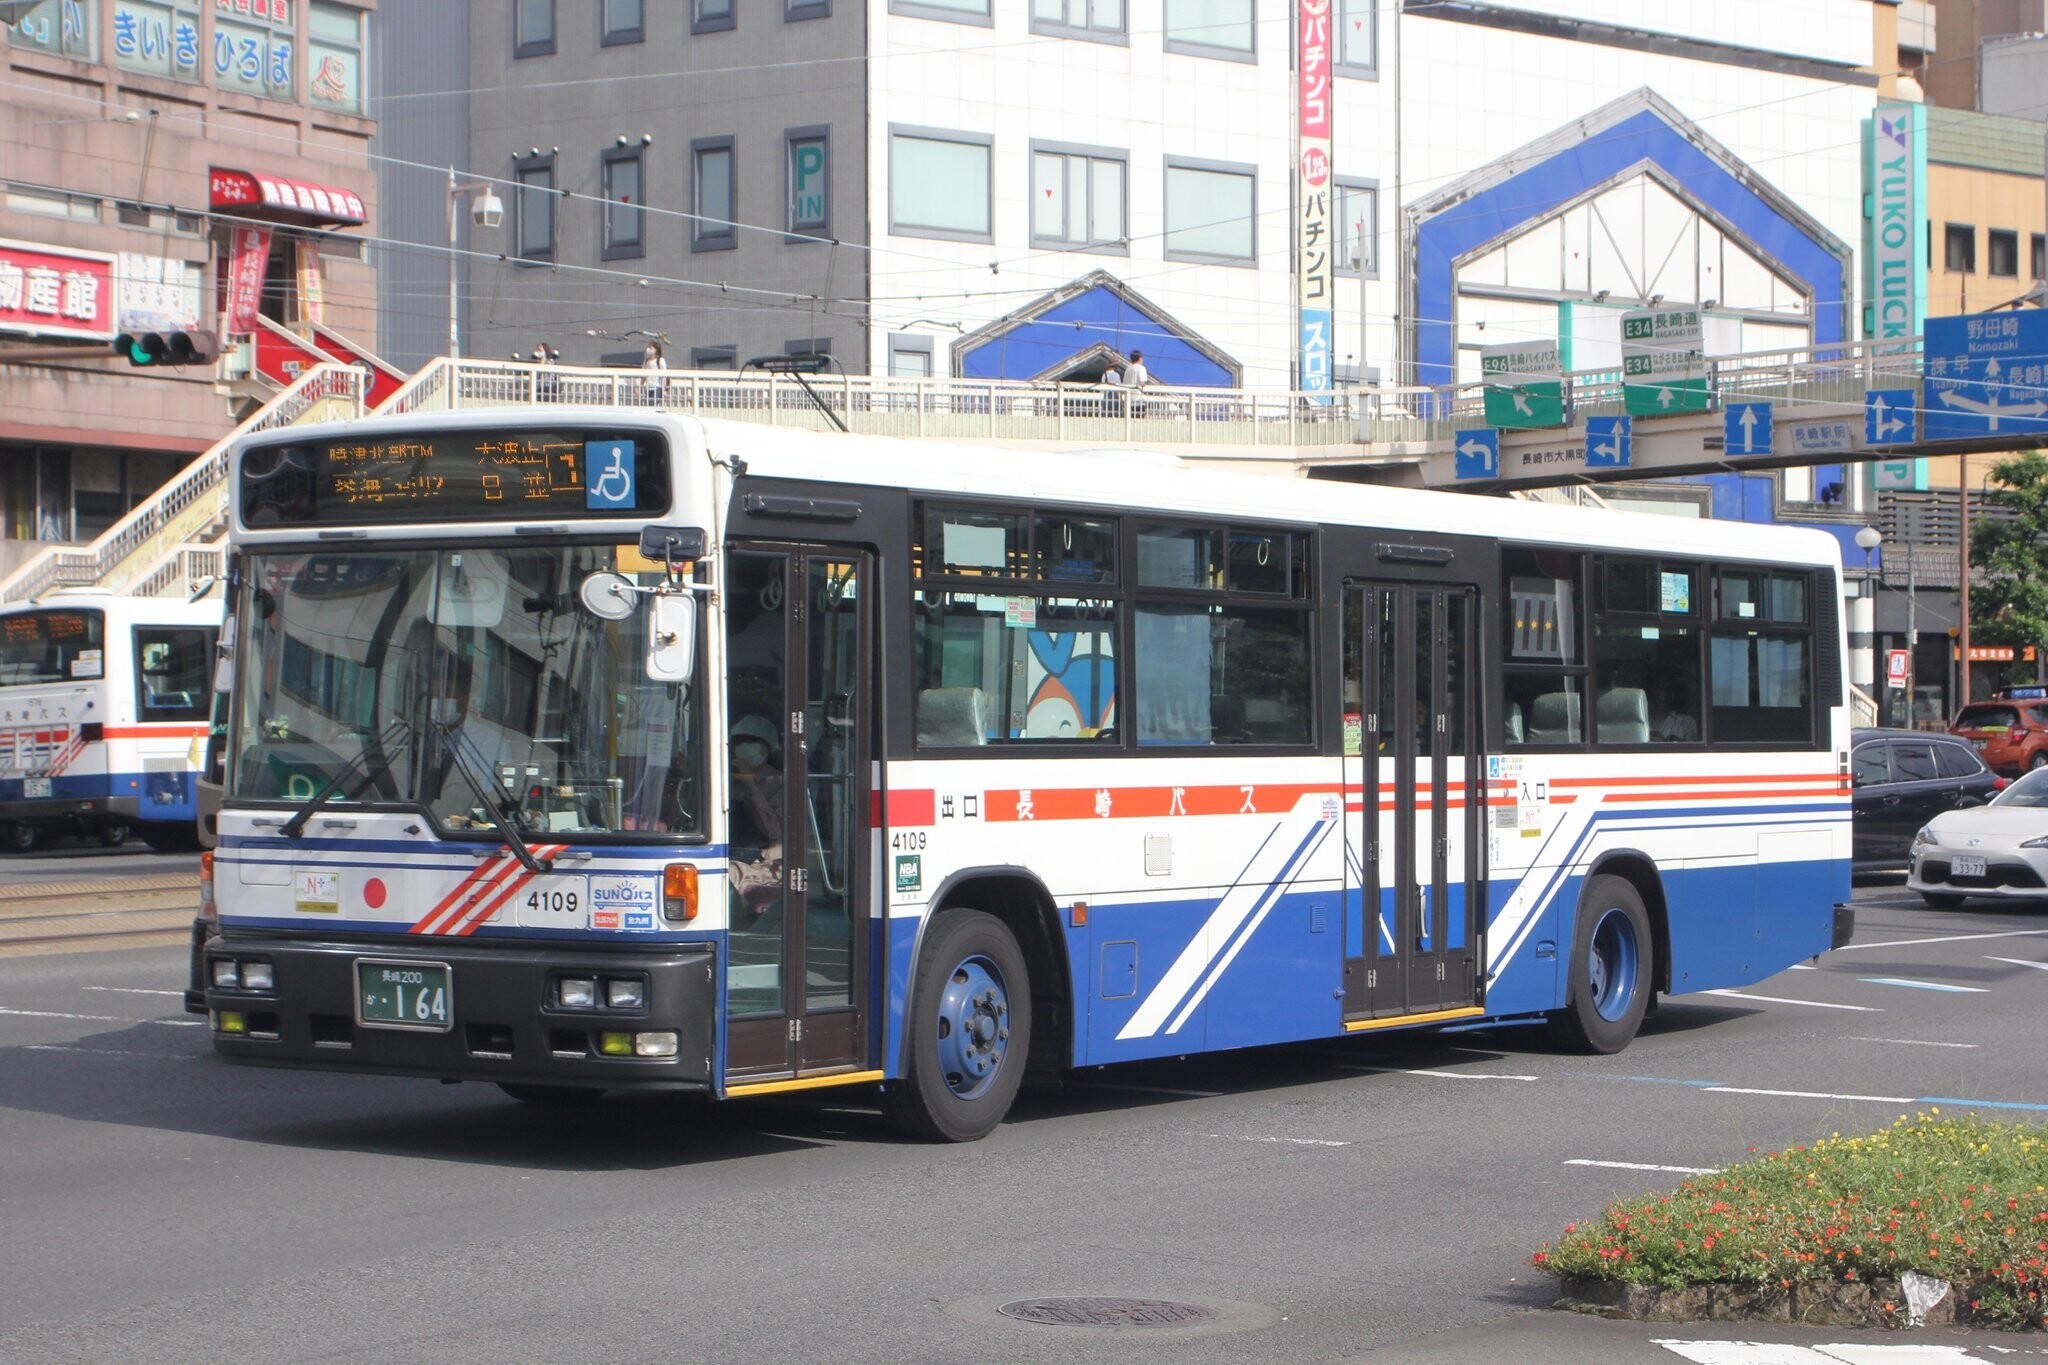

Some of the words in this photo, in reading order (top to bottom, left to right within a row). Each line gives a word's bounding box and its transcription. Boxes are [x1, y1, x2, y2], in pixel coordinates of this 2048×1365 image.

[1304, 16, 1326, 125] パチンコ
[798, 147, 823, 190] P
[799, 195, 821, 218] IN
[1882, 155, 1907, 249] YUKO
[1305, 191, 1325, 299] パチンコ
[1626, 320, 1651, 336] E34
[1656, 312, 1698, 328] 長崎道
[1967, 318, 2019, 339] 野母崎
[1968, 339, 2019, 353] Nomozaki
[1484, 359, 1507, 371] E96
[1510, 351, 1557, 365] 長崎バイパス
[1626, 358, 1651, 373] E34
[1522, 782, 1545, 801] 入口
[942, 794, 978, 819] 出口
[1016, 786, 1256, 820] 長崎バス
[892, 831, 927, 851] 4109
[900, 863, 918, 875] NBA
[528, 891, 578, 912] 4109
